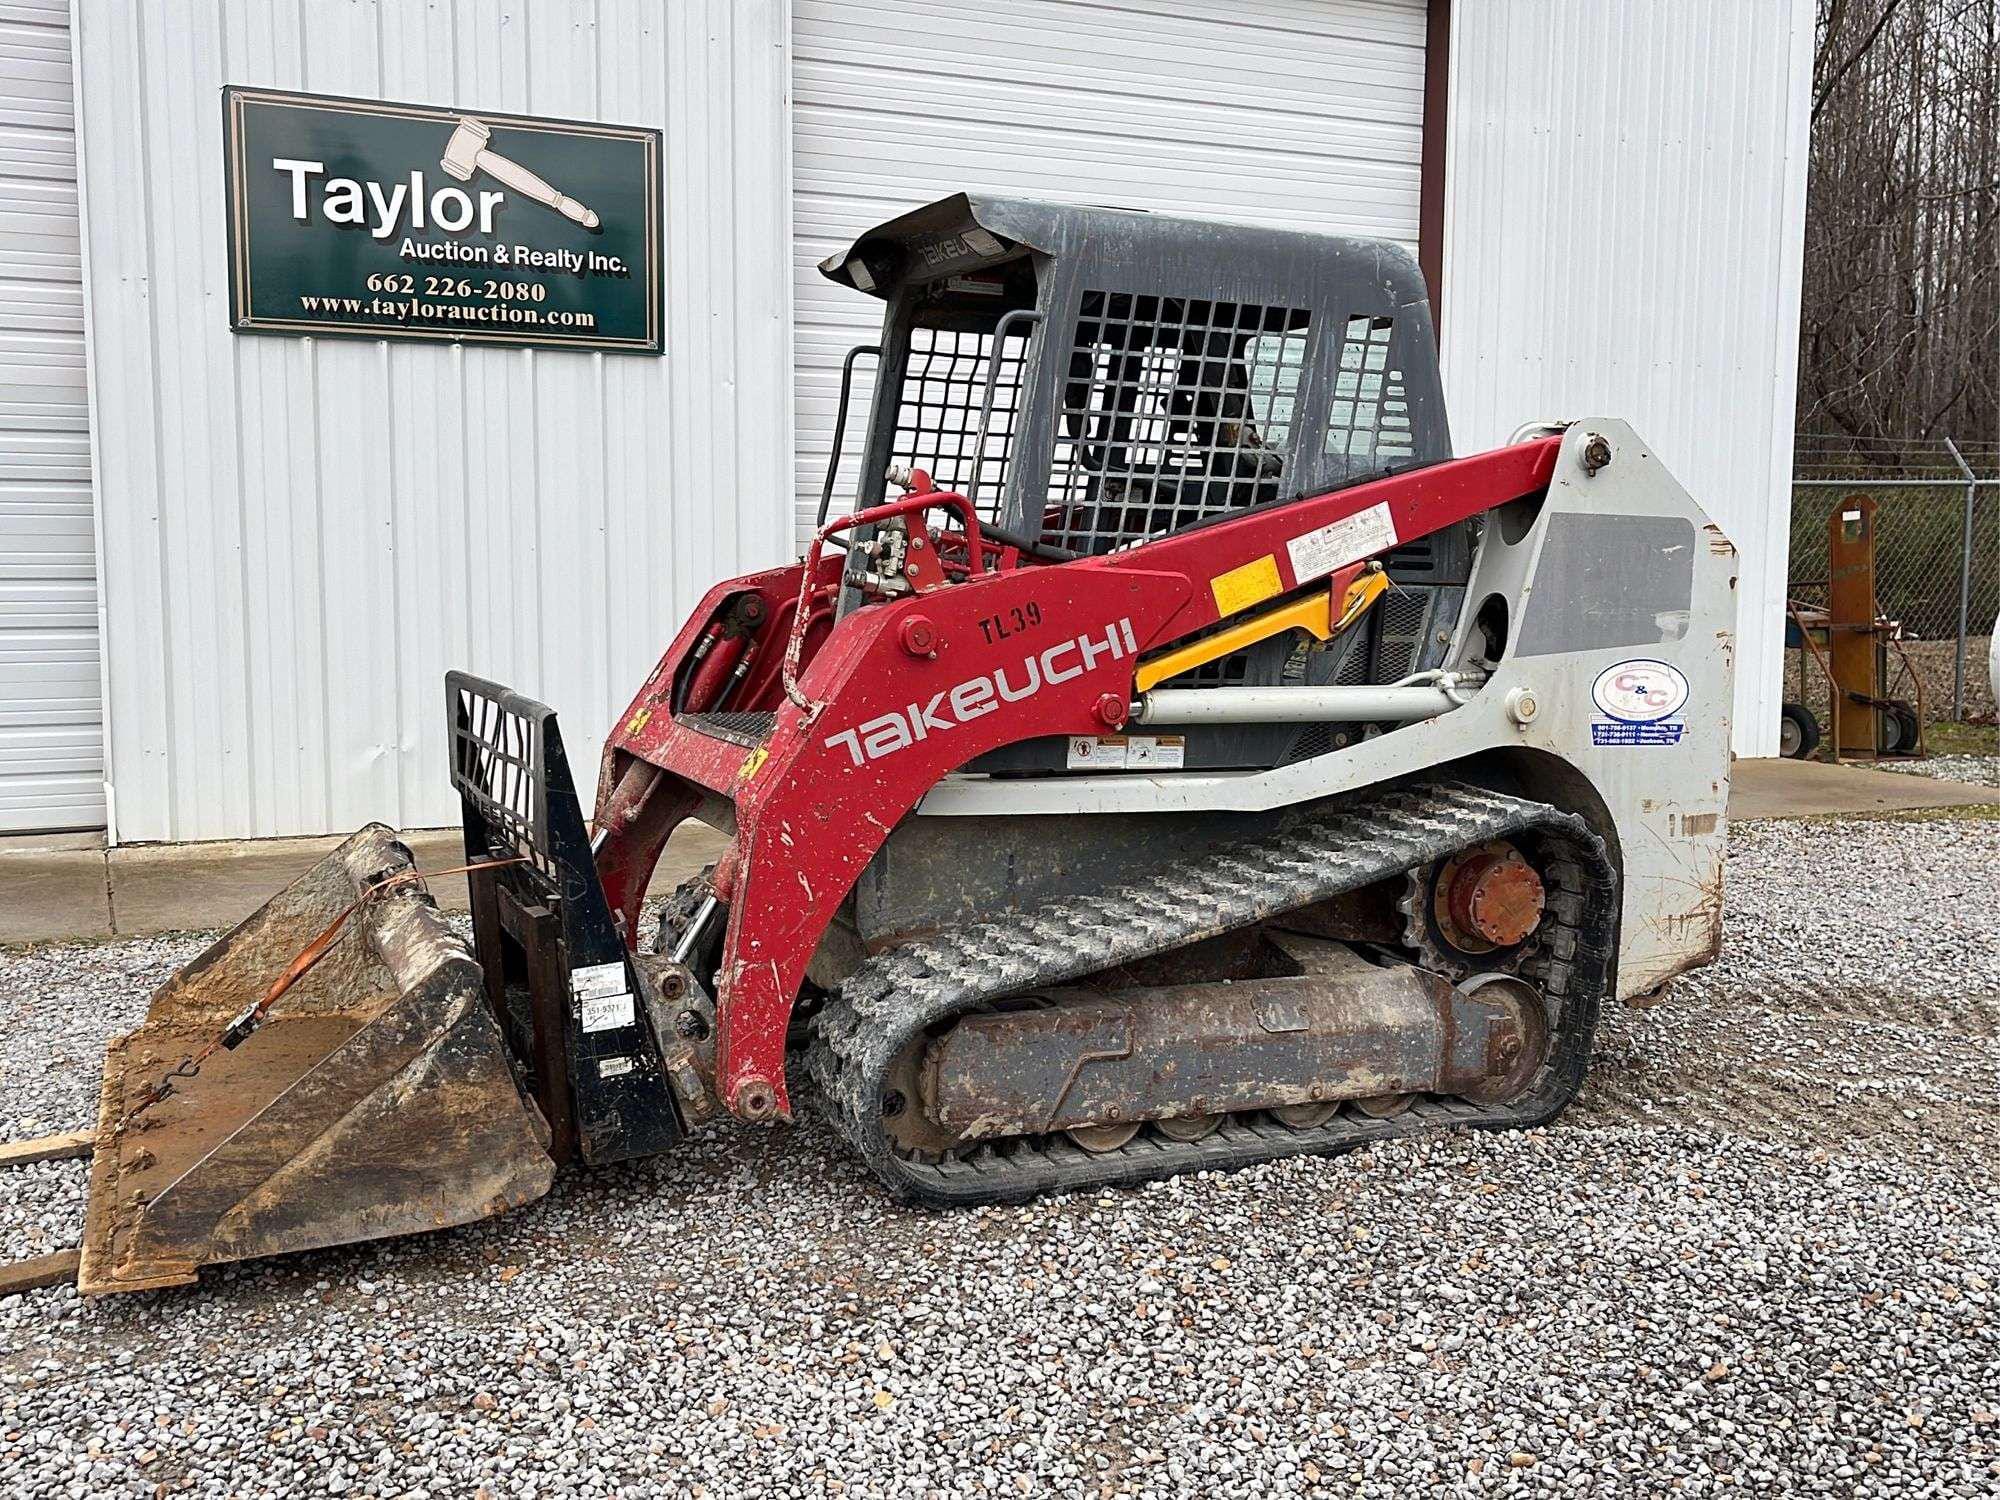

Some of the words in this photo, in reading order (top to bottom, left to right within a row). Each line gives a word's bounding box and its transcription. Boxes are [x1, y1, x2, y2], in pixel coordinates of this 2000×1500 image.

[273, 158, 504, 238] Taylor
[400, 238, 488, 264] Auction
[493, 245, 509, 265] &
[514, 246, 584, 273] Realty
[588, 251, 627, 272] Inc.
[367, 273, 414, 295] 662
[424, 276, 546, 302] 226-2080
[300, 295, 595, 327] www.taylorauction.com
[978, 601, 1042, 645] TL39
